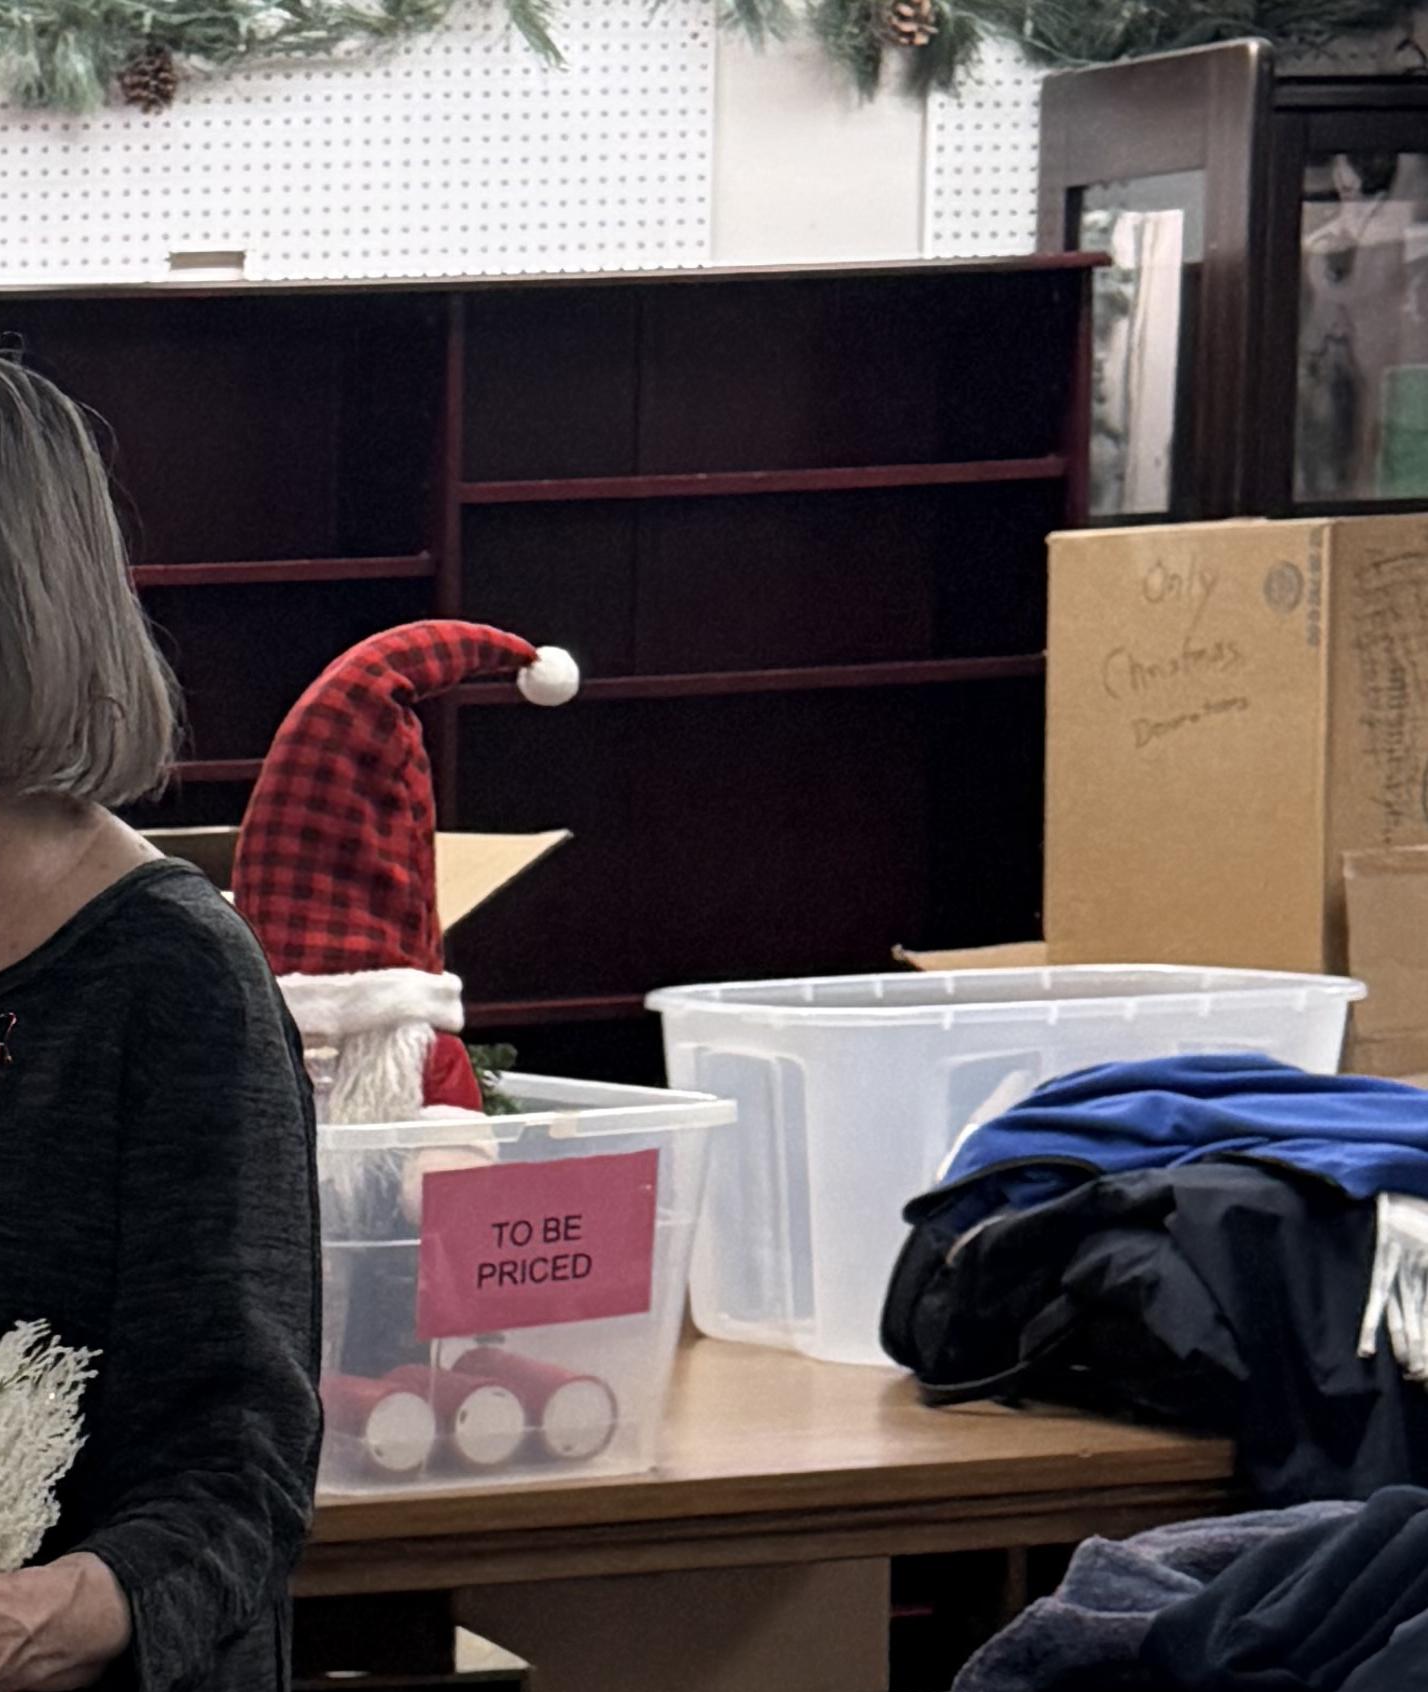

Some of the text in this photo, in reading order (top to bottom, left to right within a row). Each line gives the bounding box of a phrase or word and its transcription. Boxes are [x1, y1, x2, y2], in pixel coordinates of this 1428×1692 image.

[491, 1213, 584, 1250] TO BE
[476, 1252, 594, 1290] PRICED
